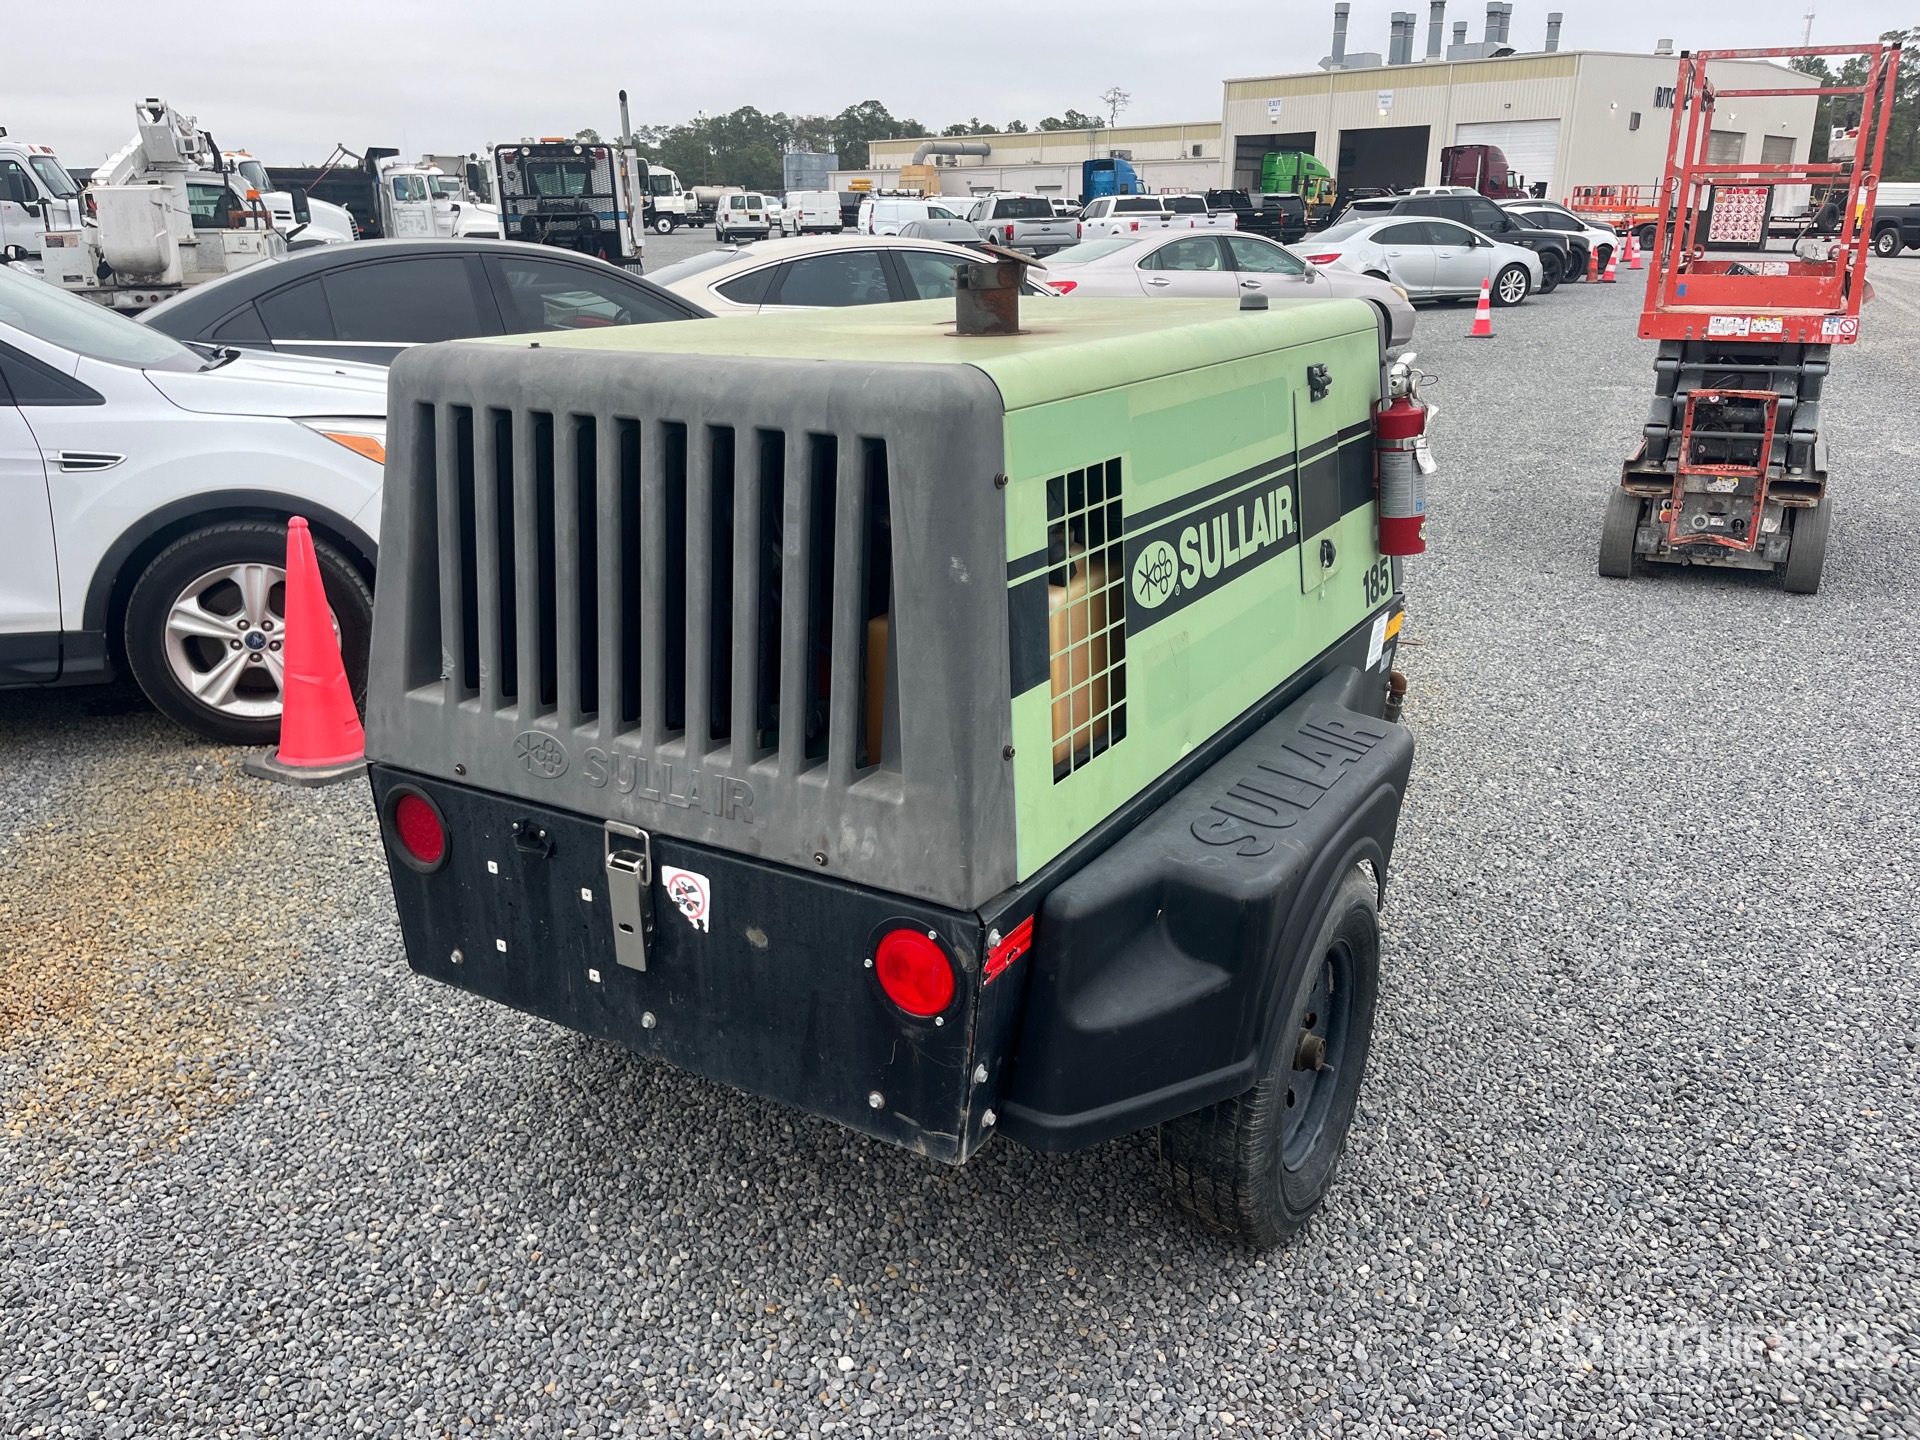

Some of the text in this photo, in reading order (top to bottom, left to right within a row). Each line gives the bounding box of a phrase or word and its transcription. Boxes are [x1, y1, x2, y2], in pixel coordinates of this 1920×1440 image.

[1268, 99, 1281, 107] EXIT
[1179, 484, 1293, 590] SULLAIR
[1363, 556, 1389, 608] 185
[583, 746, 755, 825] SULLAIR
[1190, 720, 1388, 857] SULLAIR
